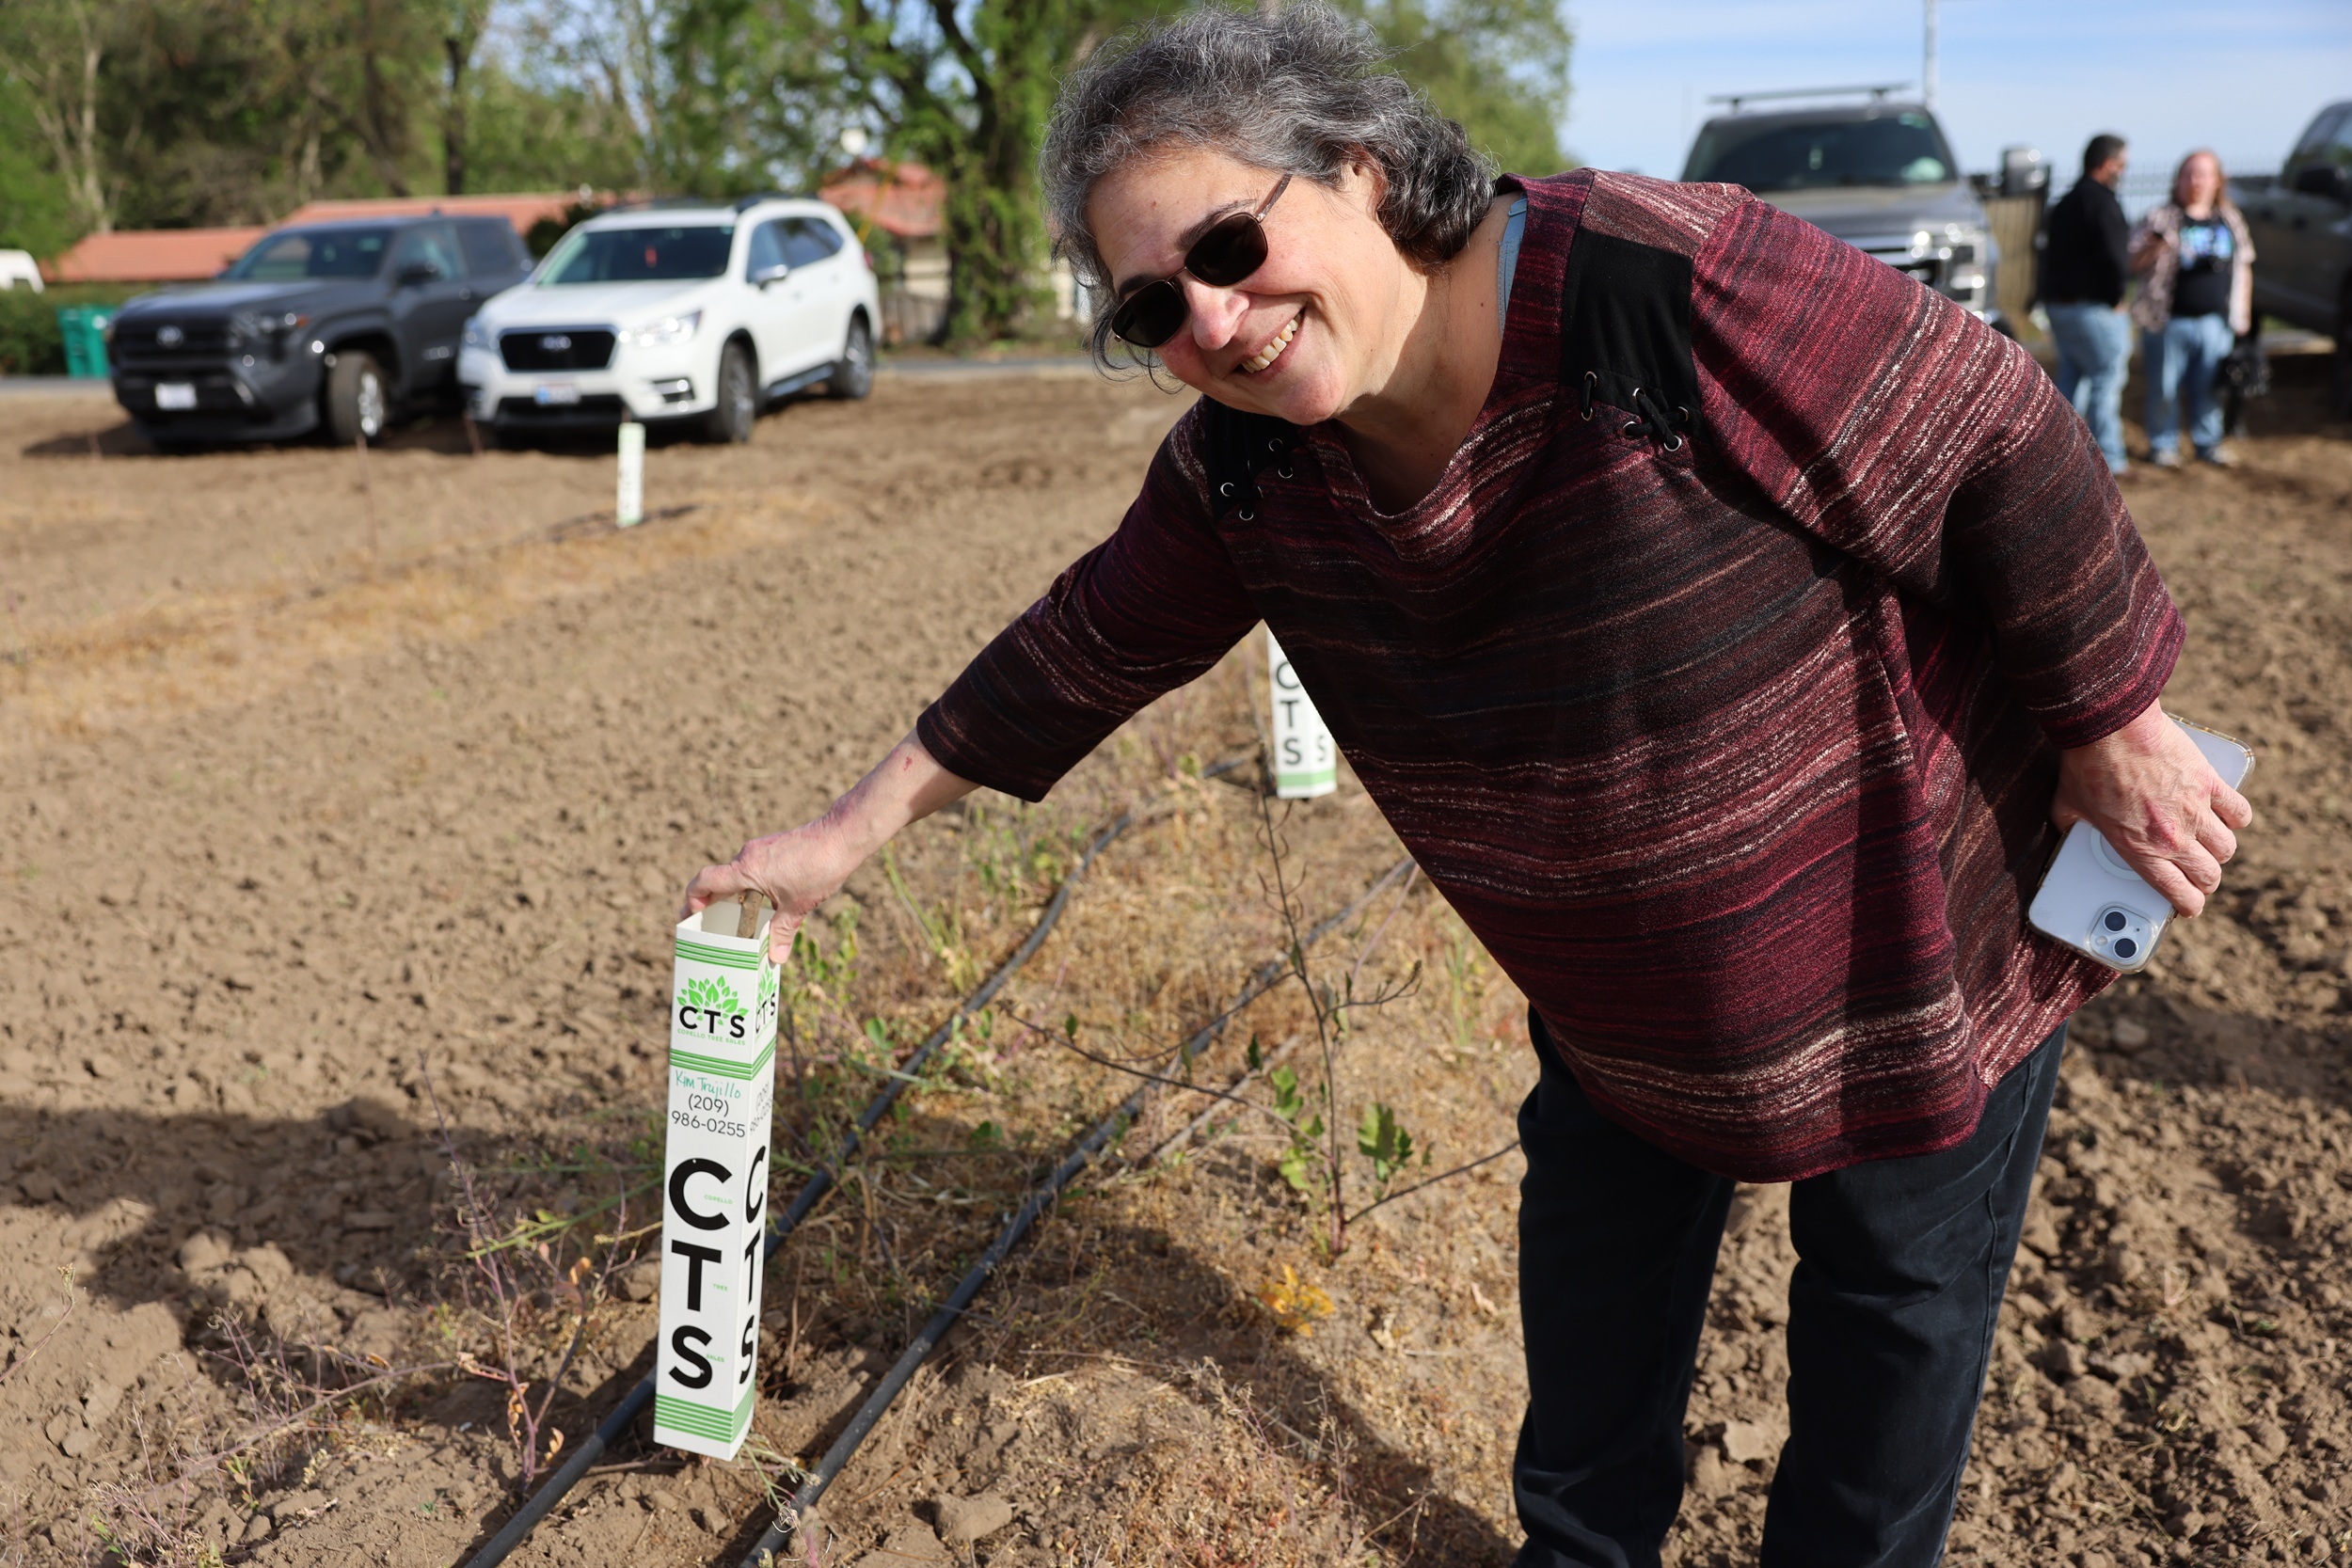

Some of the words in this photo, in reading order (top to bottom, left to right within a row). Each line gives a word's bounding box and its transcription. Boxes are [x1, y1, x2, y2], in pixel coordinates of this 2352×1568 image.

[679, 1006, 745, 1038] CTS
[755, 992, 776, 1033] CTS
[677, 1028, 706, 1038] COPELLO
[725, 1037, 746, 1046] SALES
[675, 1069, 694, 1088] Kim
[689, 1093, 729, 1117] (209)
[672, 1111, 745, 1137] 986-0255
[704, 1194, 733, 1205] COPELLO
[669, 1158, 732, 1389] CTS
